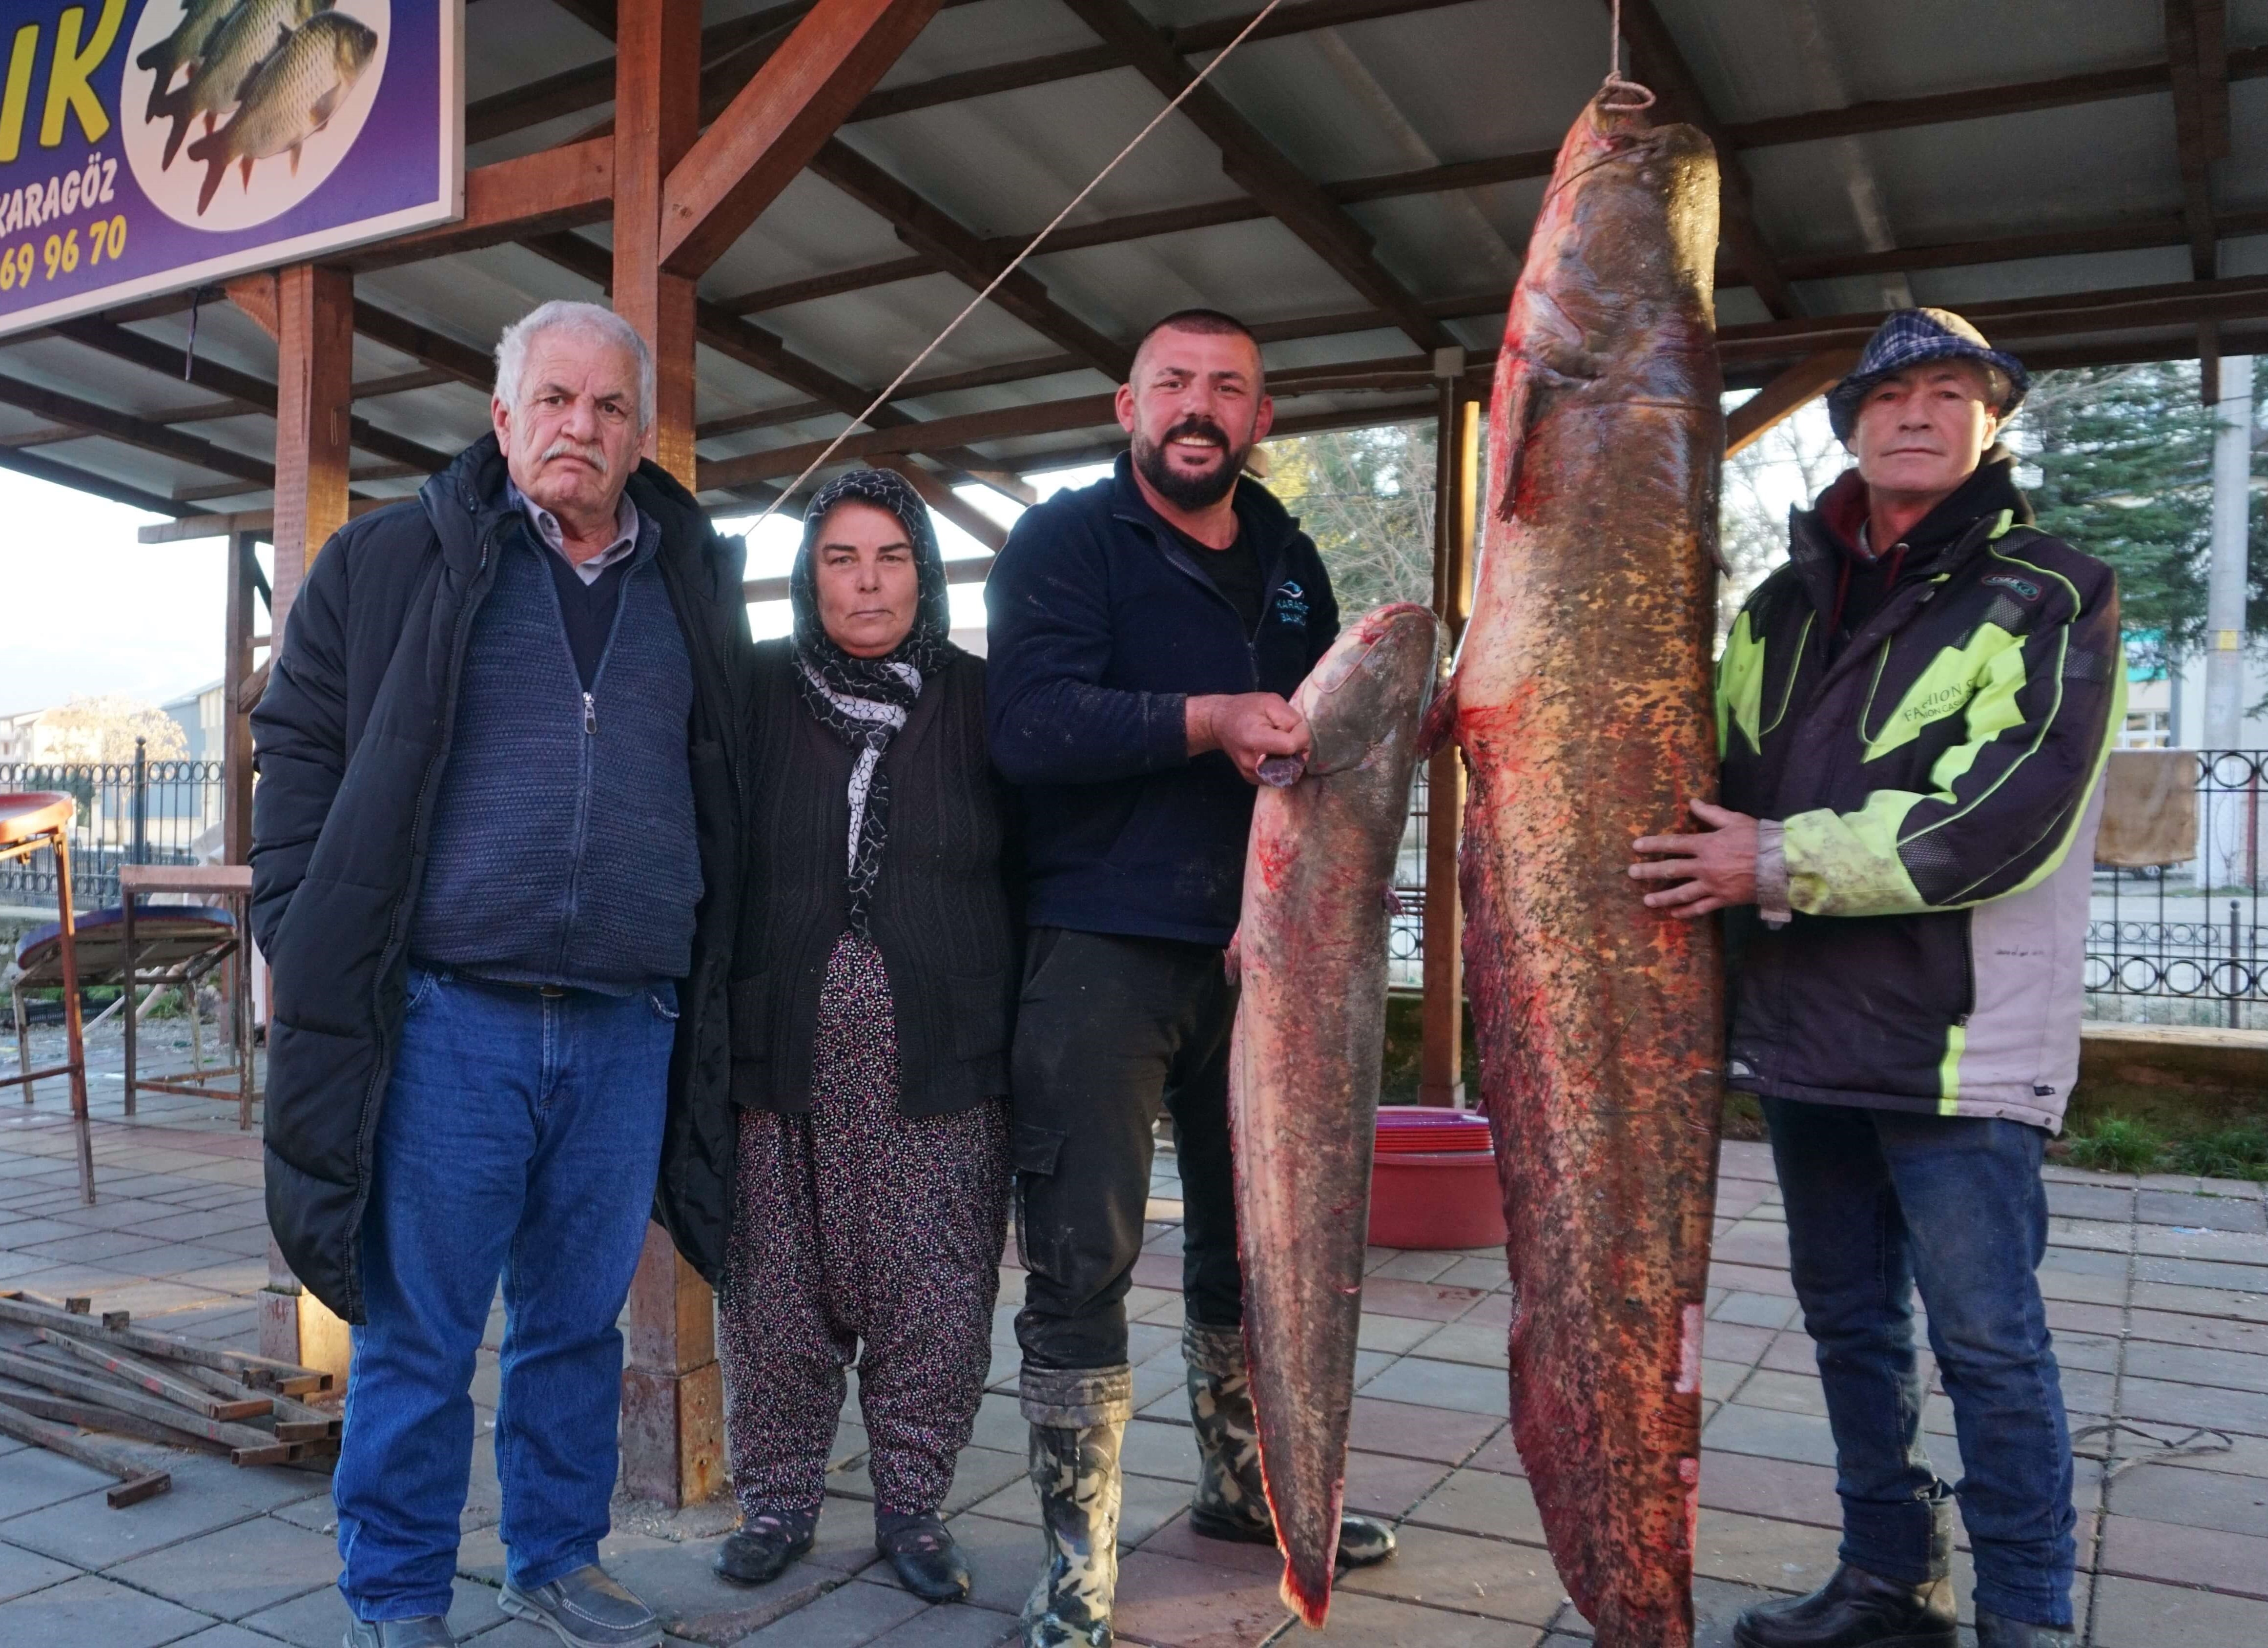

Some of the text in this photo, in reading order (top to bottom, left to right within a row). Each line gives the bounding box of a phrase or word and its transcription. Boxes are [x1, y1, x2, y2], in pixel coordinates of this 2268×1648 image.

[0, 214, 127, 290] 69 96 70
